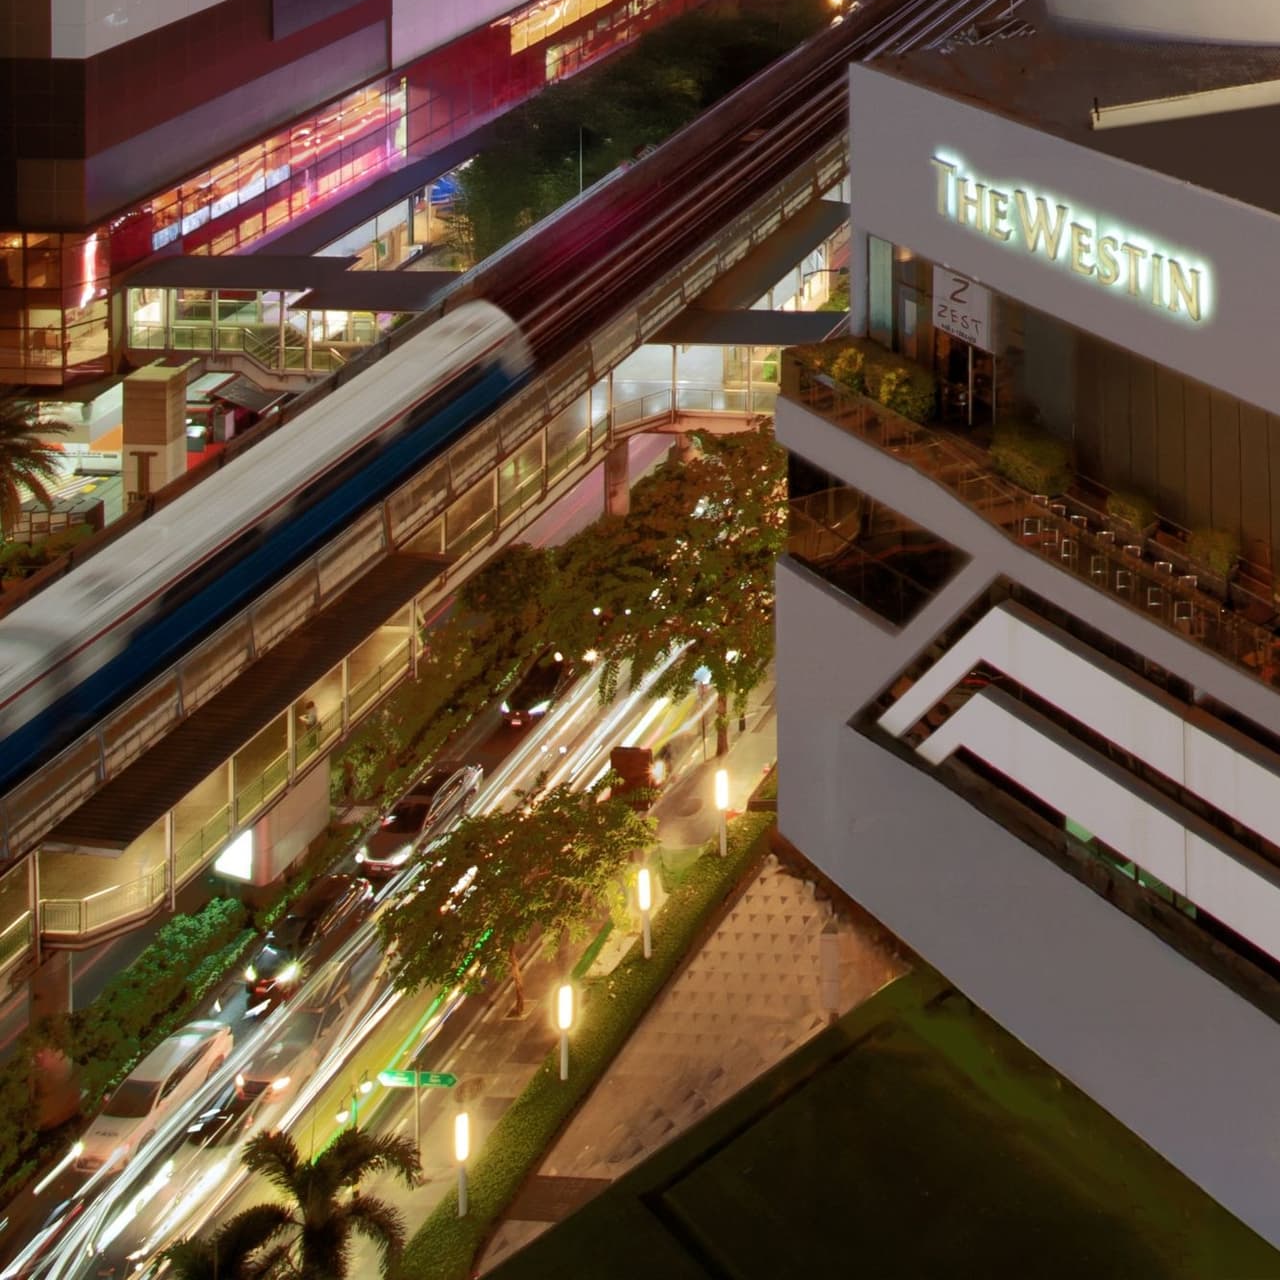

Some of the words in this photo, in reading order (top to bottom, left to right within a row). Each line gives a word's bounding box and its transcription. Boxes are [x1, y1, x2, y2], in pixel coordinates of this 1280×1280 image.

[930, 155, 1014, 241] THE
[1014, 188, 1202, 322] WESTIN
[950, 277, 970, 304] Z
[937, 304, 982, 337] ZEST
